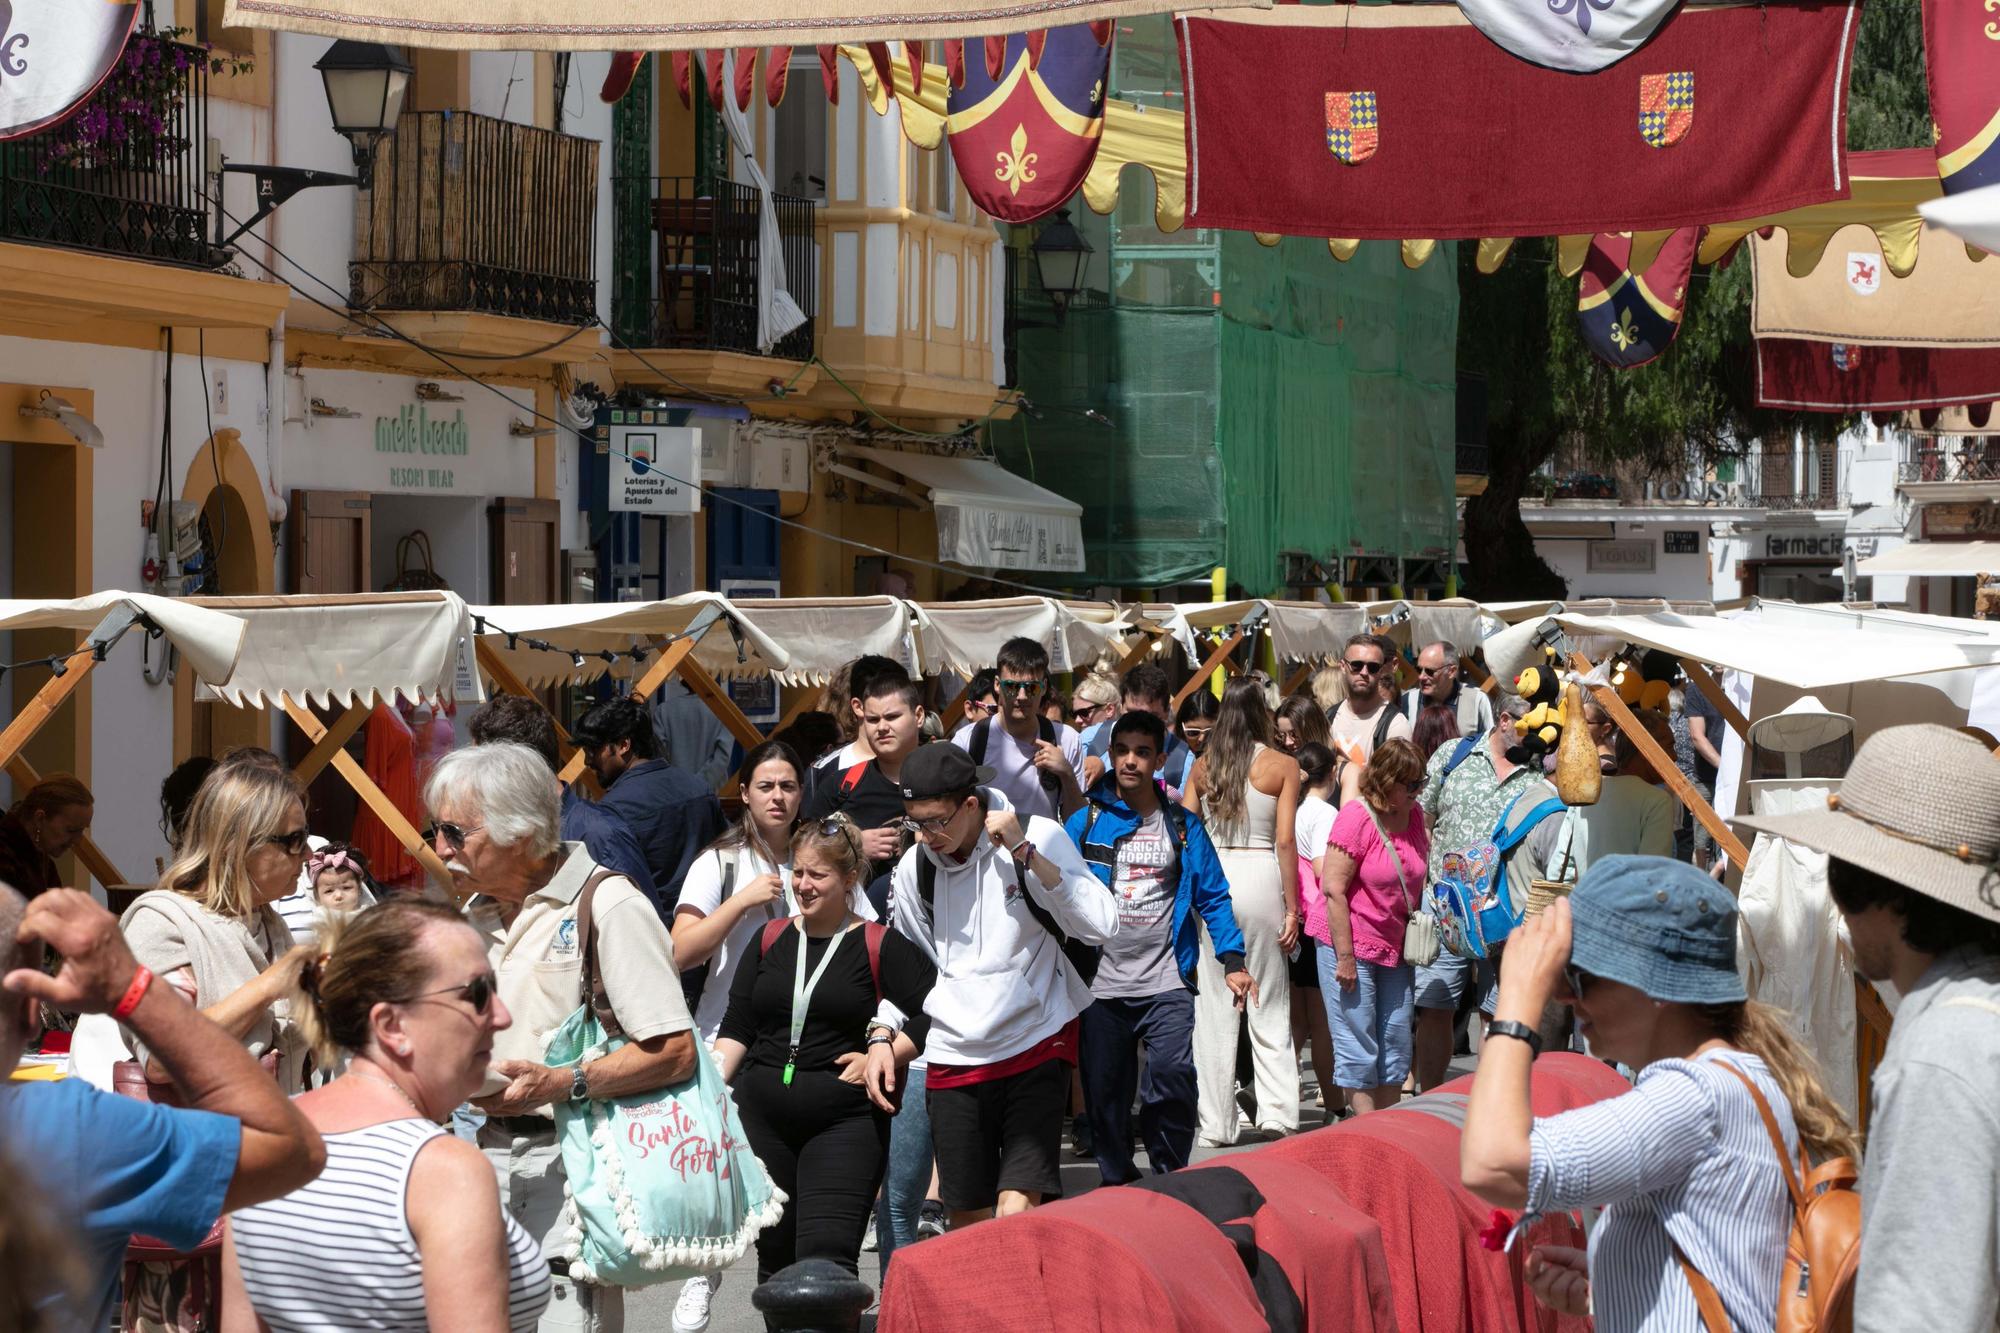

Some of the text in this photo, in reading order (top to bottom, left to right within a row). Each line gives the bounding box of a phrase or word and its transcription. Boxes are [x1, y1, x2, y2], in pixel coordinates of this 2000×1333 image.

[420, 406, 469, 455] beach
[390, 467, 454, 488] RESORT WEAR
[624, 476, 665, 487] Loterías y
[625, 486, 678, 496] Apuestas del
[624, 496, 653, 505] Estado
[1766, 533, 1844, 557] farmacia
[1120, 838, 1170, 852] MERICAN
[1117, 850, 1168, 864] HOPPER
[628, 1101, 697, 1159] Santa
